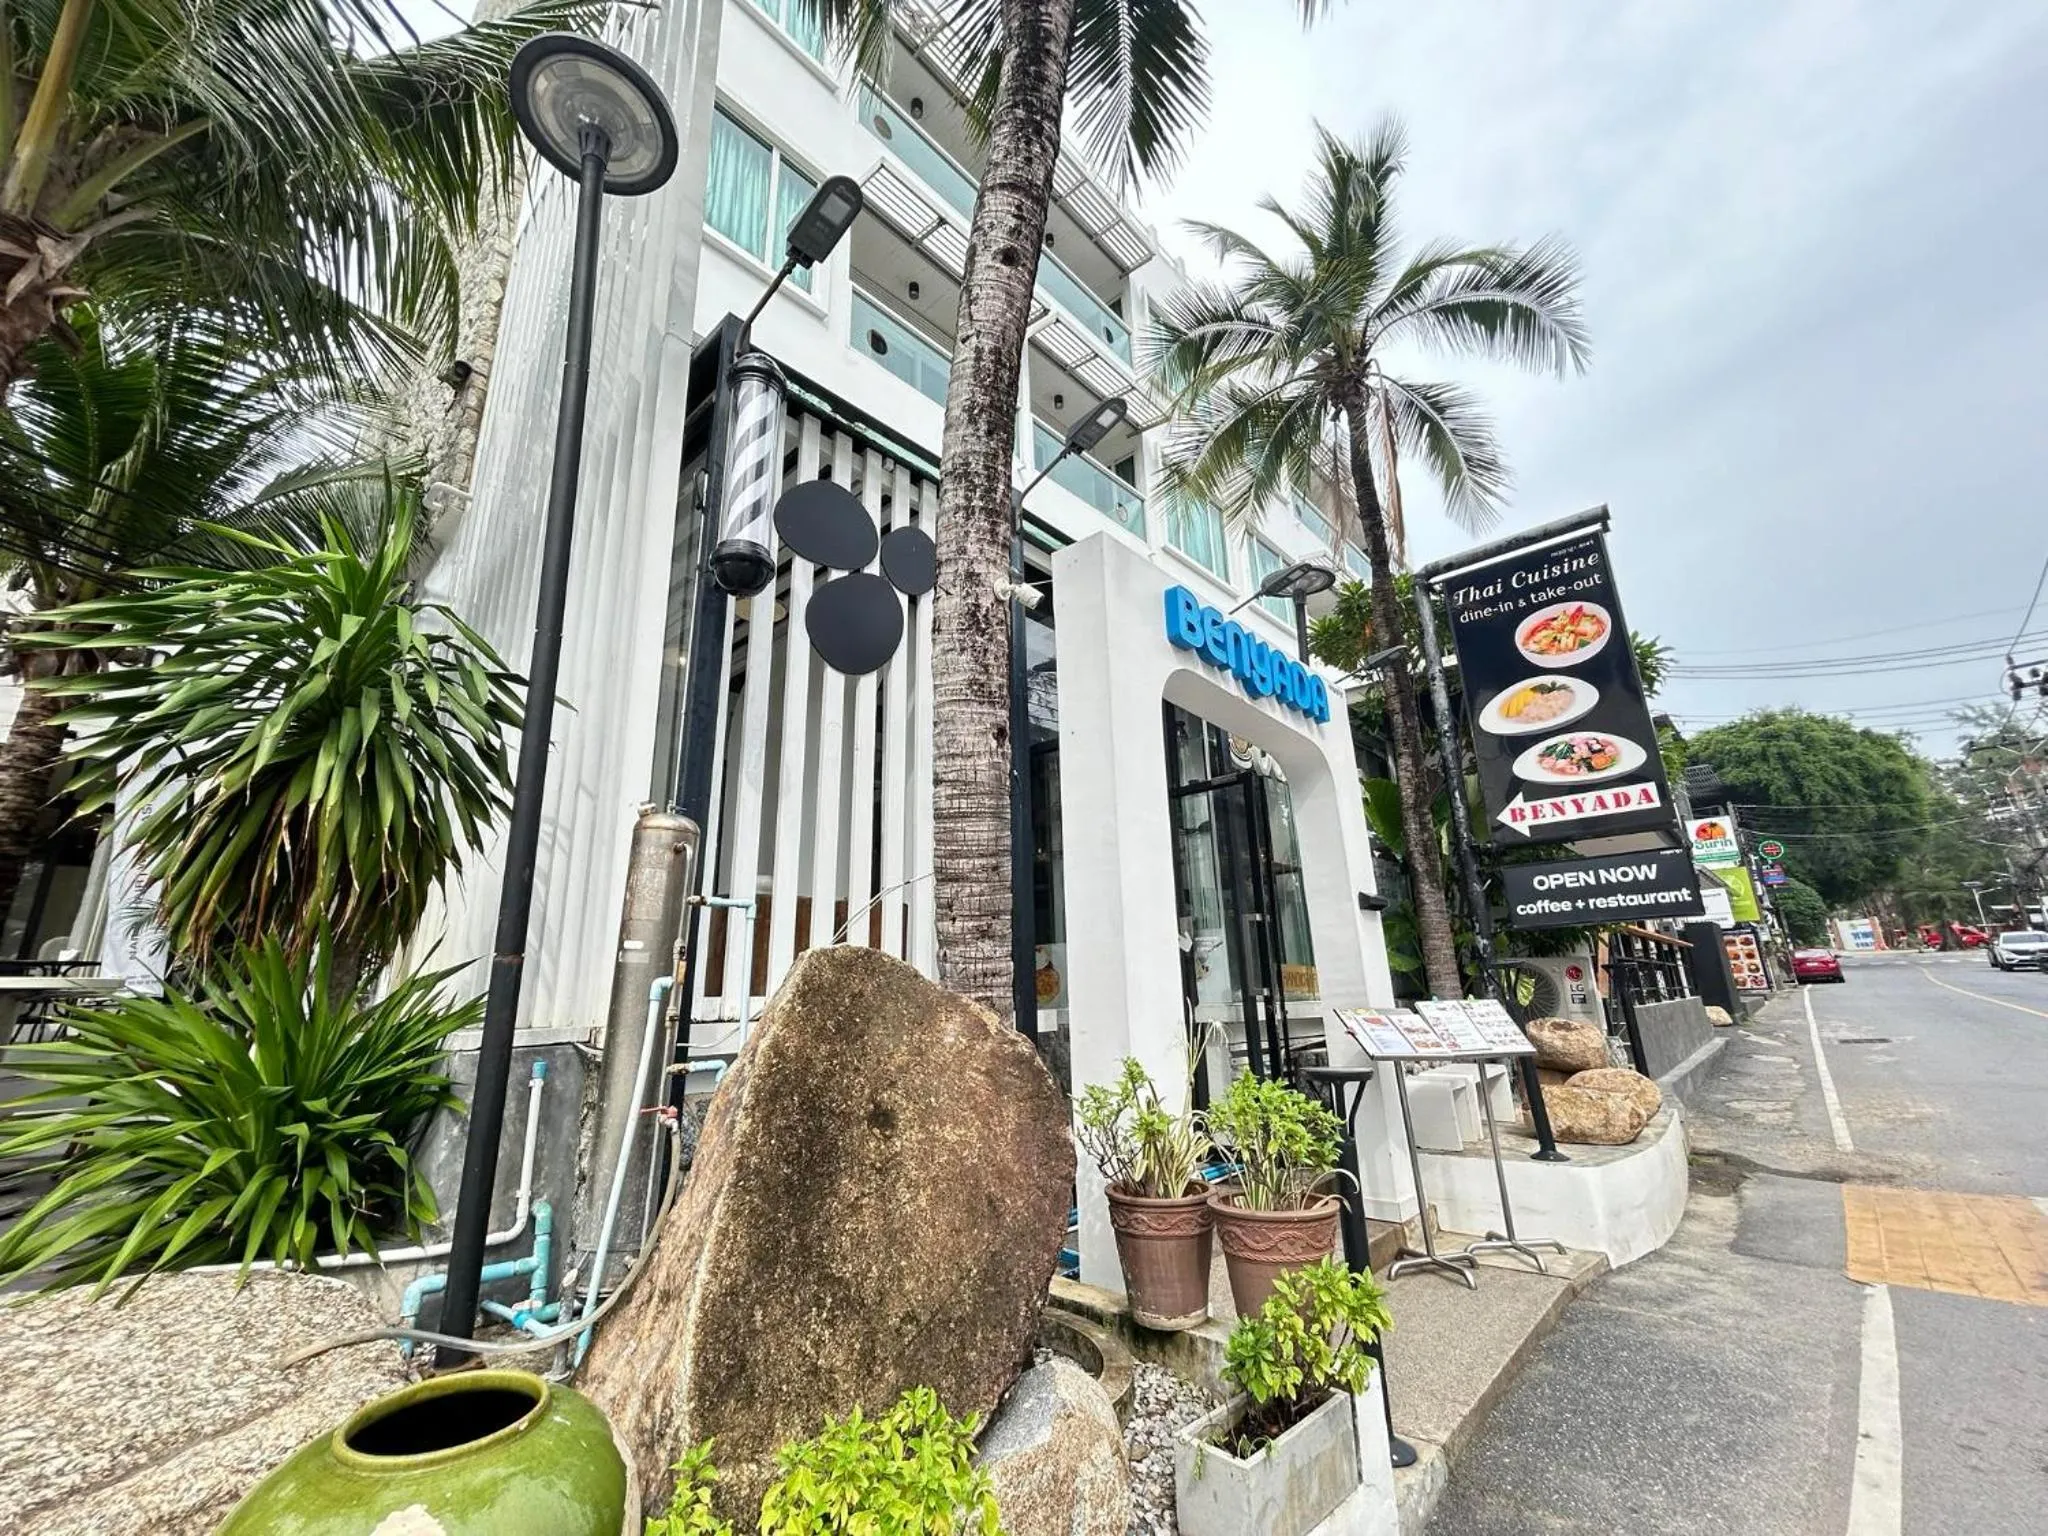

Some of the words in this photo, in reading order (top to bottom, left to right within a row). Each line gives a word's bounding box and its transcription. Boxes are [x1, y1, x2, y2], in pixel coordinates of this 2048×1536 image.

[1453, 578, 1503, 606] Thai
[1511, 552, 1600, 588] Cuisine
[1459, 601, 1514, 624] dine-in
[1530, 572, 1603, 603] take-out
[1509, 787, 1656, 823] BENYADA
[1694, 838, 1733, 850] Surin
[1532, 869, 1596, 891] OPEN
[1599, 863, 1657, 885] NOW
[1516, 899, 1573, 916] coffee
[1572, 899, 1585, 909] +
[1588, 887, 1693, 910] restaurant
[1569, 983, 1585, 992] LG
